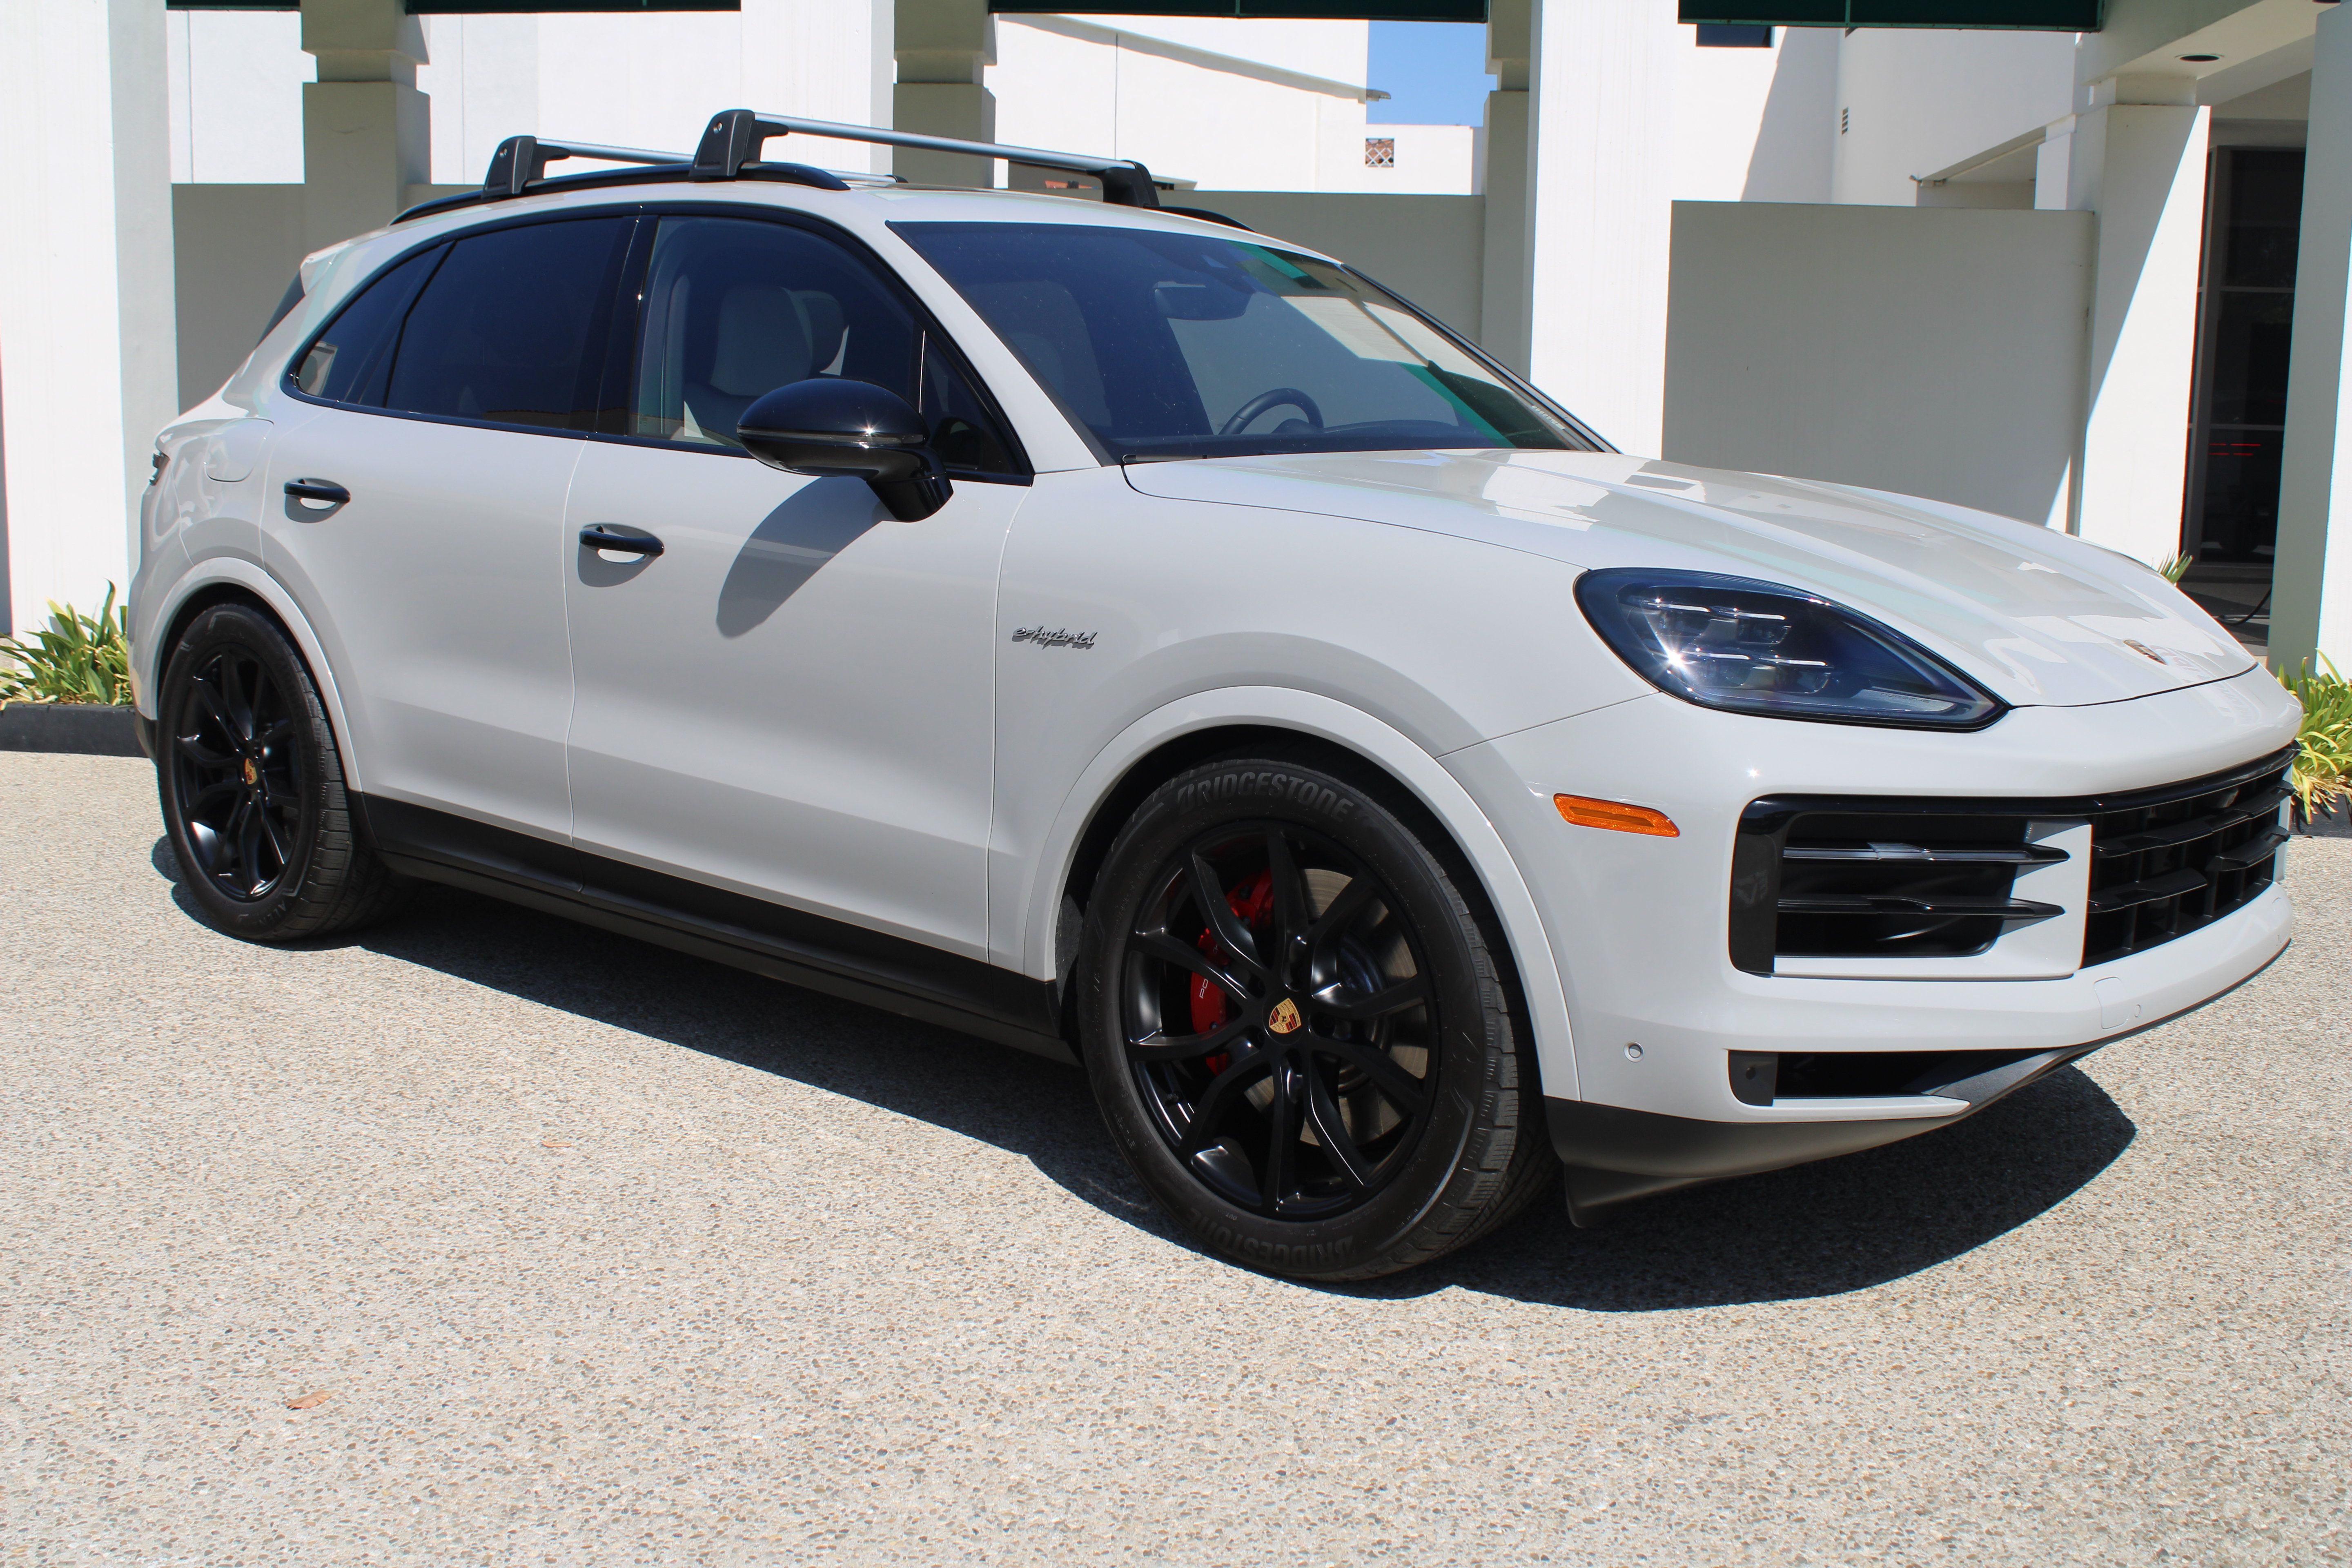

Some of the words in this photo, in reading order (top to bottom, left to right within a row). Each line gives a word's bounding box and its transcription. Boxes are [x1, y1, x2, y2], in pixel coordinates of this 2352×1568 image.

[1013, 626, 1097, 644] e-hybrid
[1177, 771, 1354, 822] BRIDGESTONE
[1187, 1207, 1354, 1267] BRIDGESTONE
